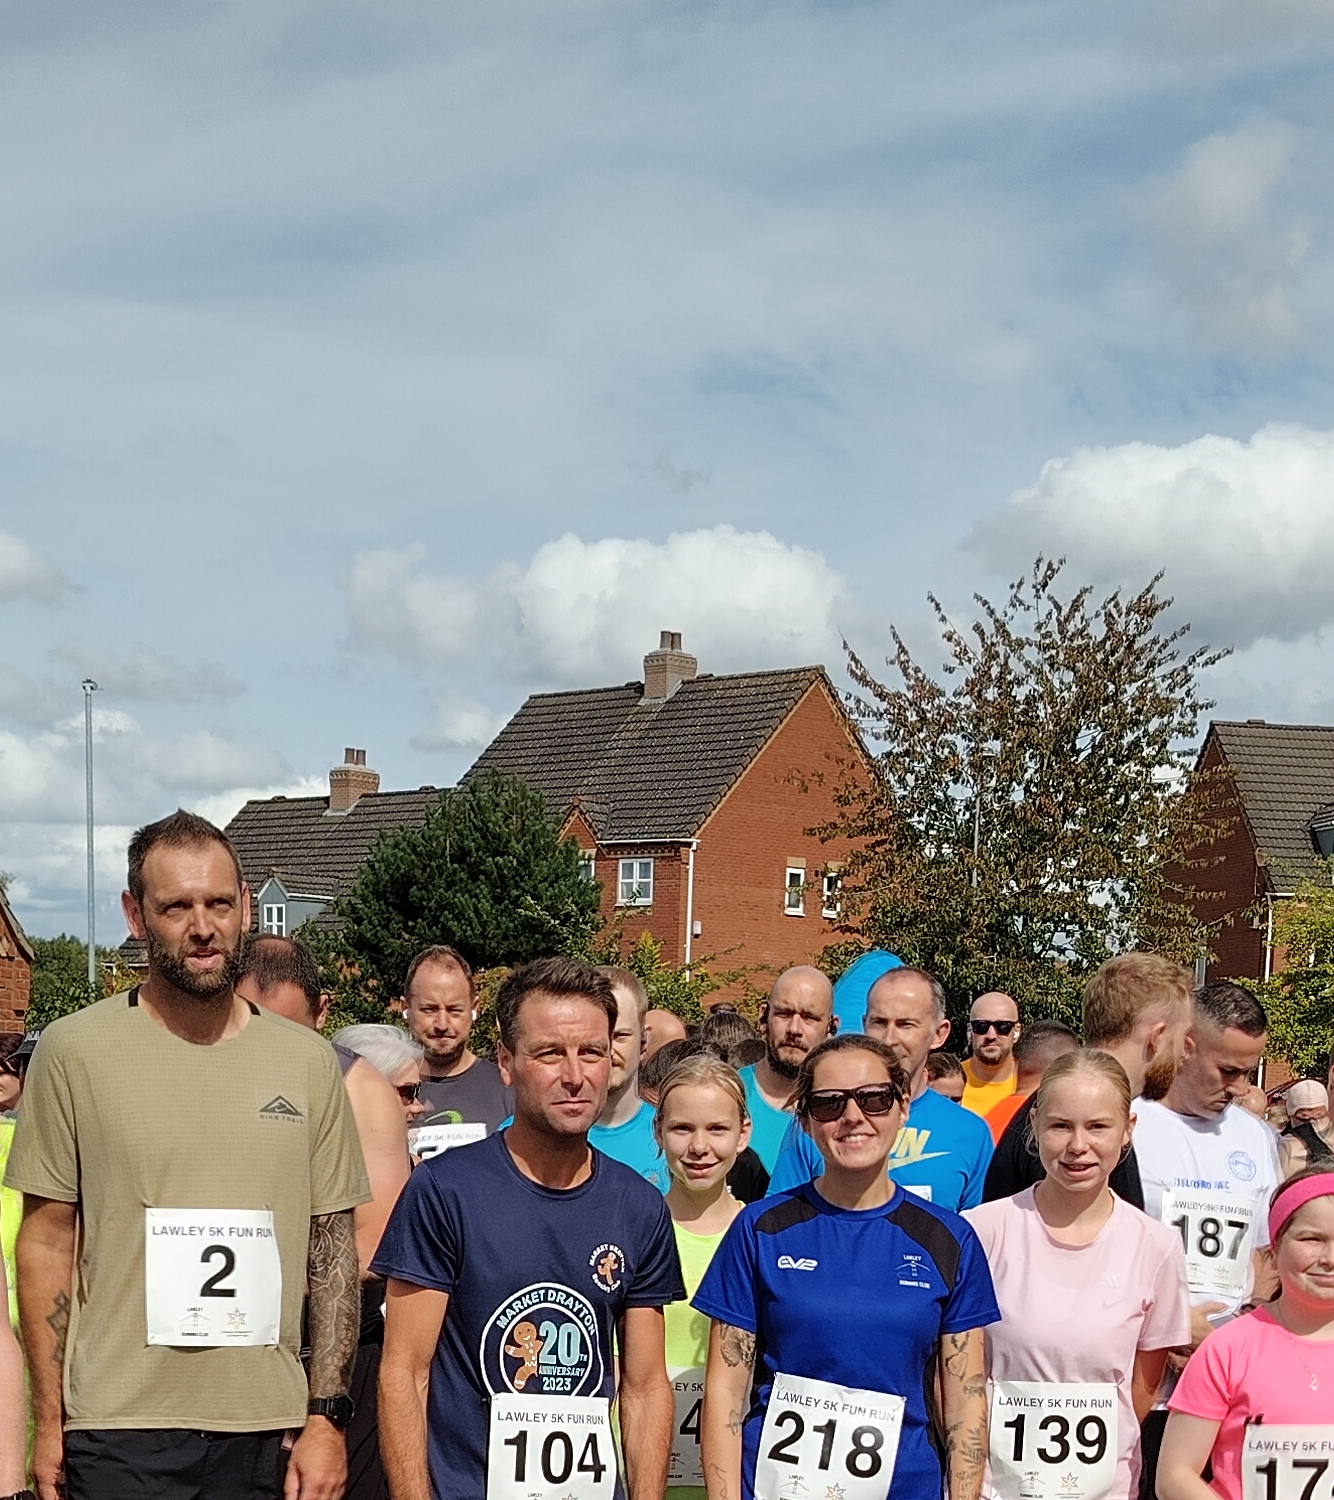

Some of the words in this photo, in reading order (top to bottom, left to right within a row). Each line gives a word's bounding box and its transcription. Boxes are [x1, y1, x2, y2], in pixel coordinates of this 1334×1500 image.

[152, 1226, 205, 1236] LAWLEY
[209, 1227, 224, 1236] 5K
[229, 1227, 253, 1237] FUN
[256, 1228, 273, 1238] RUN
[1171, 1214, 1249, 1260] 187
[200, 1244, 237, 1298] 2
[496, 1289, 546, 1329] MARKET
[547, 1289, 596, 1336] DRAYTON
[539, 1320, 581, 1367] 20
[539, 1365, 585, 1377] ANNIVERSARY
[543, 1377, 572, 1391] 2023
[691, 1383, 704, 1392] 5K
[497, 1411, 548, 1423] LAWLEY
[551, 1413, 564, 1423] 5K
[567, 1414, 584, 1424] FUN
[587, 1415, 604, 1425] RUN
[679, 1398, 703, 1445] 4
[776, 1390, 821, 1408] LAWLEY
[823, 1400, 839, 1412] 5K
[842, 1404, 866, 1417] FUN
[869, 1409, 895, 1422] RUN
[999, 1397, 1044, 1408] LAWLEY
[1048, 1399, 1062, 1408] 5K
[1065, 1399, 1087, 1408] FUN
[1091, 1399, 1112, 1408] RUN
[504, 1430, 606, 1485] 104
[768, 1410, 884, 1478] 218
[1004, 1413, 1107, 1464] 139
[1249, 1440, 1298, 1450] LAWLEY
[1302, 1441, 1317, 1451] 5K
